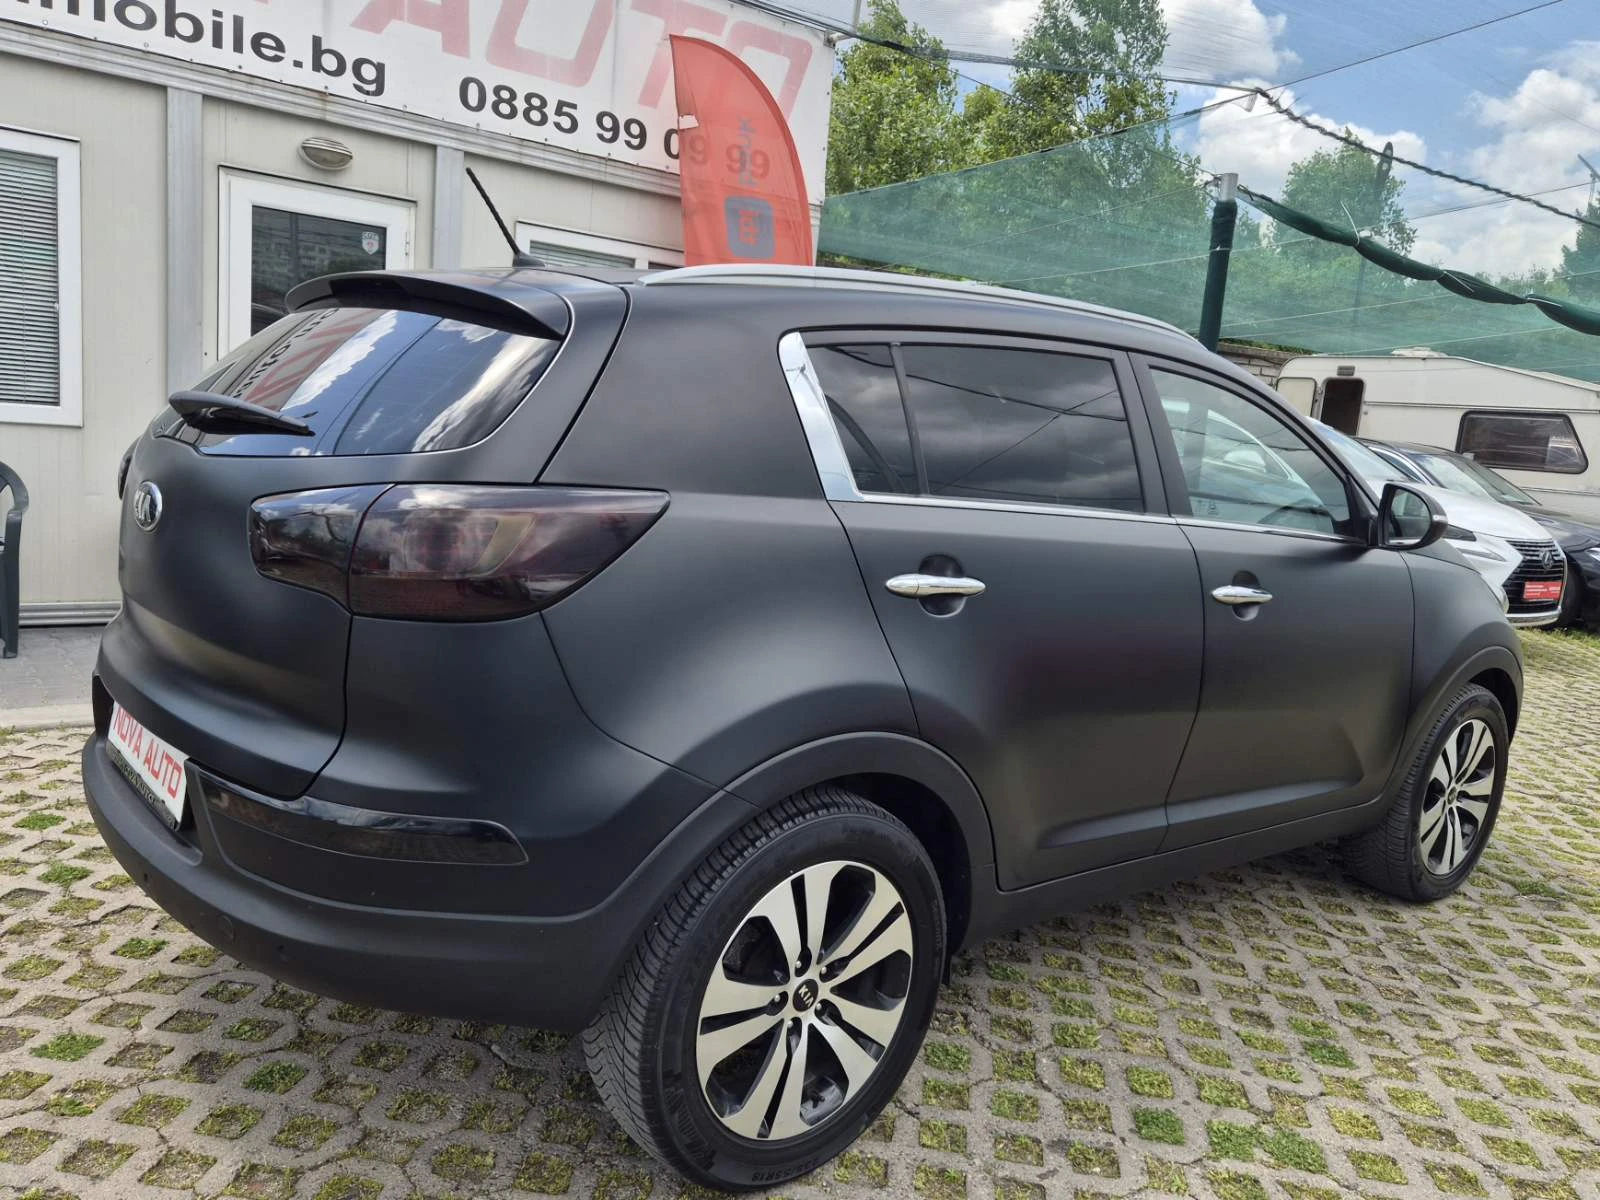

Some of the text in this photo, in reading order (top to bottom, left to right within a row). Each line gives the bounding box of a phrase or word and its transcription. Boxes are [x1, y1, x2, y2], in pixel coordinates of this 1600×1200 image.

[458, 76, 579, 135] 0885
[595, 111, 648, 151] 99
[113, 707, 143, 760] NOVA
[143, 739, 183, 799] AUTO
[798, 984, 814, 1008] KIA
